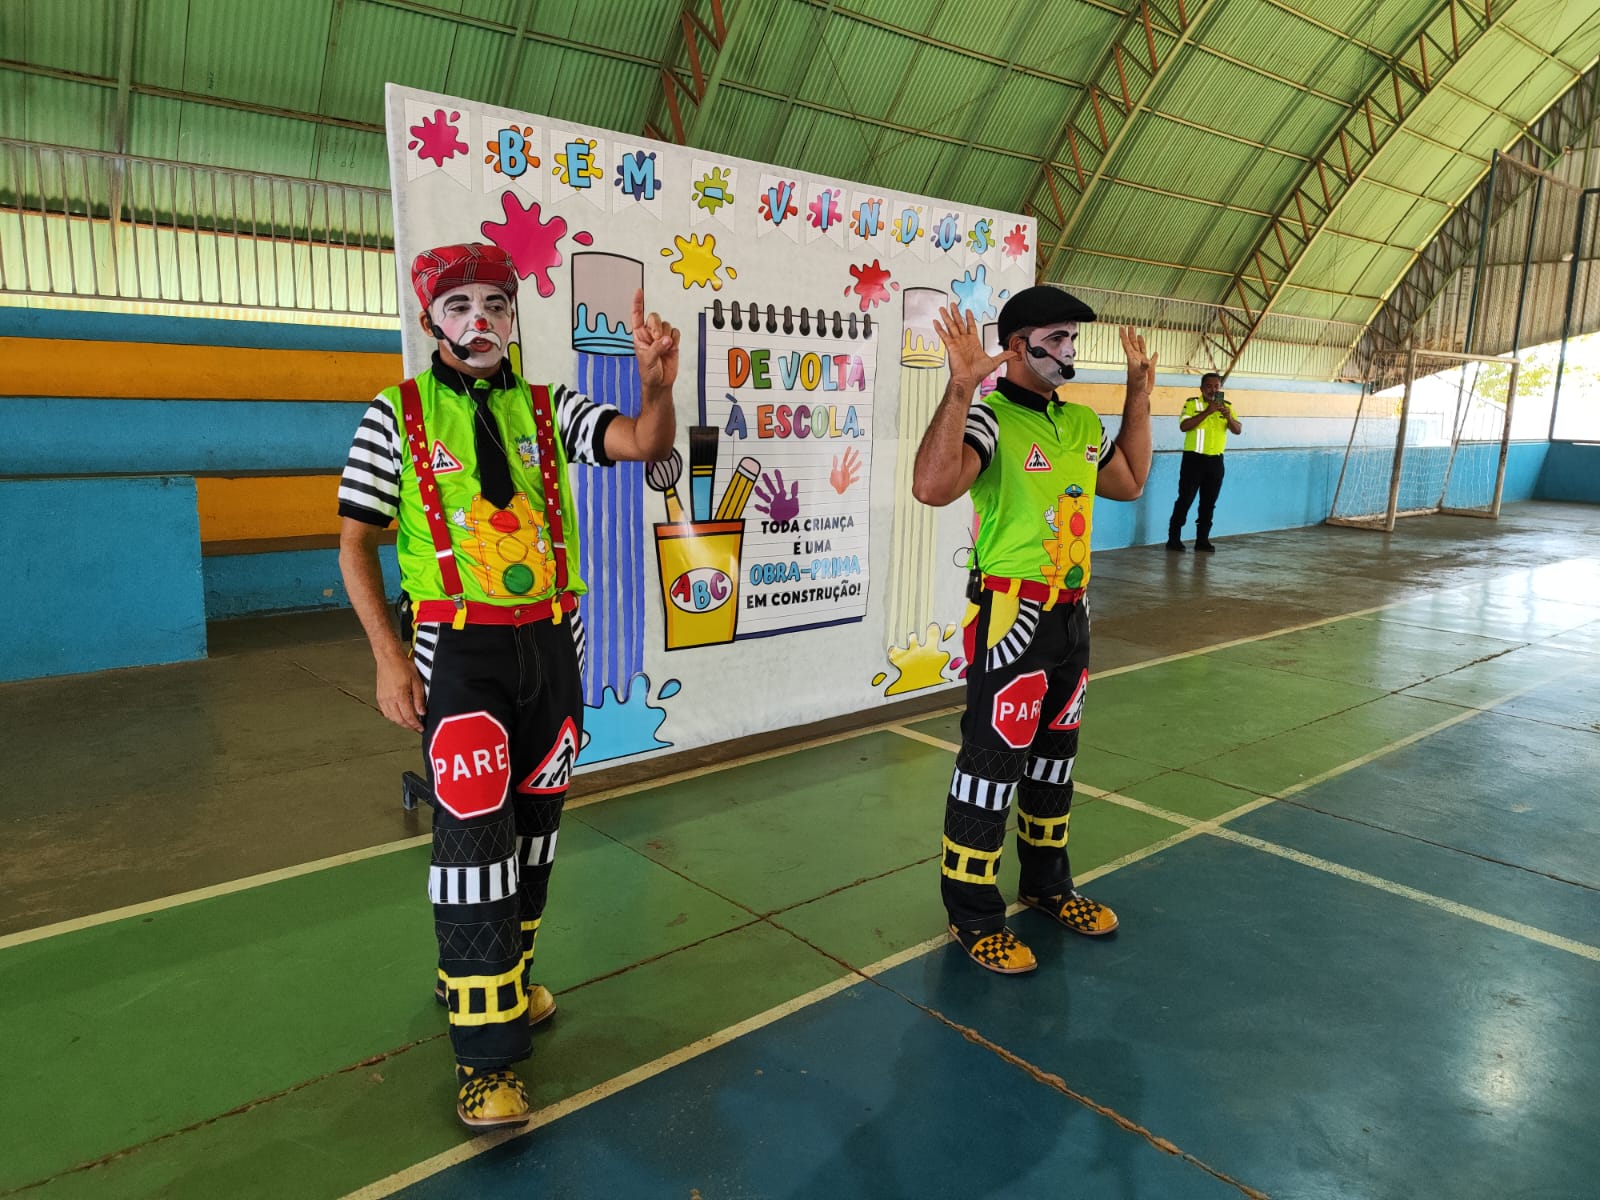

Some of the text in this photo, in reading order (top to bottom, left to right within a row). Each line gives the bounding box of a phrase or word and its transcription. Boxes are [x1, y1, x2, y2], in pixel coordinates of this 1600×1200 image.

[728, 348, 866, 391] DE VOLTA
[725, 392, 865, 440] À ESCOLA.
[761, 515, 854, 534] TODA CRIANÇA
[793, 535, 832, 555] É UMA
[749, 555, 861, 586] OBRA-PRIMA
[671, 572, 727, 610] ABC
[746, 580, 861, 609] EM CONSTRUÇÃO!
[1000, 700, 1042, 721] PAR
[435, 743, 507, 785] PARE
